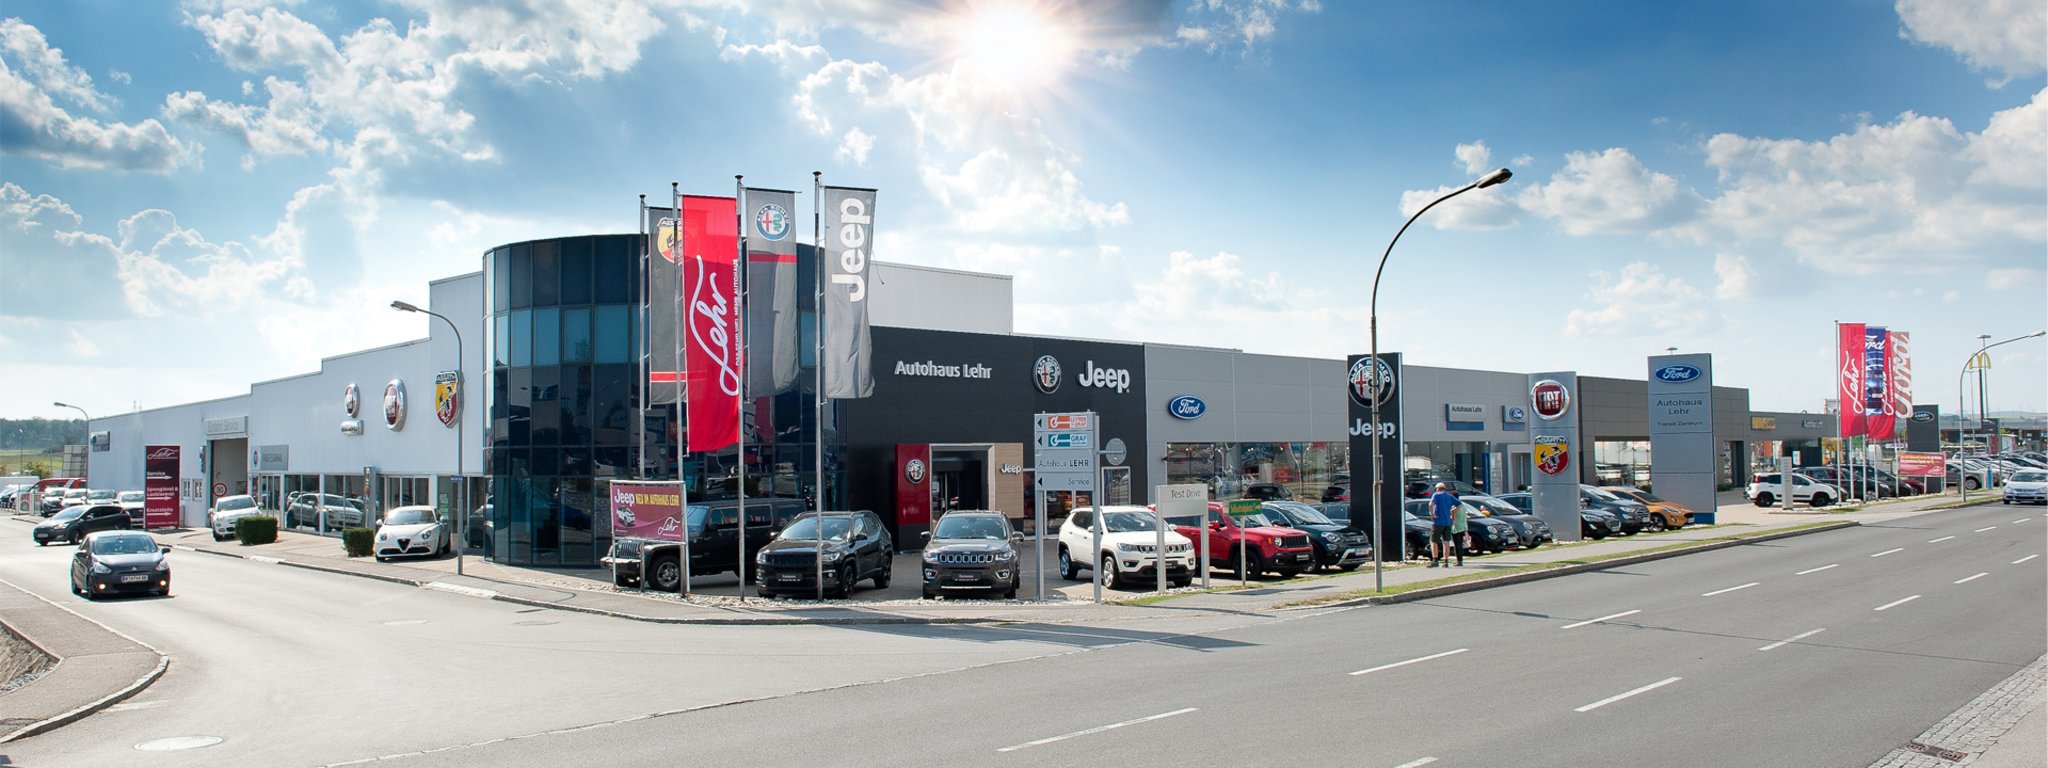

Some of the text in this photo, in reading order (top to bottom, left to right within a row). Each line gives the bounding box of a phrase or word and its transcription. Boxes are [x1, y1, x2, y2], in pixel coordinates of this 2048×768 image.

[832, 197, 869, 302] Jeep
[690, 254, 738, 396] Lehr
[894, 360, 992, 379] Autohaus Lehr
[1079, 360, 1130, 394] Jeep
[1663, 367, 1691, 379] Ford
[1890, 334, 1913, 418] Ford
[1841, 350, 1864, 414] Lehr
[1178, 398, 1200, 414] Ford
[1001, 463, 1021, 474] Jeep
[1069, 459, 1089, 467] LEHR
[614, 489, 635, 507] Jeep
[1171, 489, 1185, 498] Test
